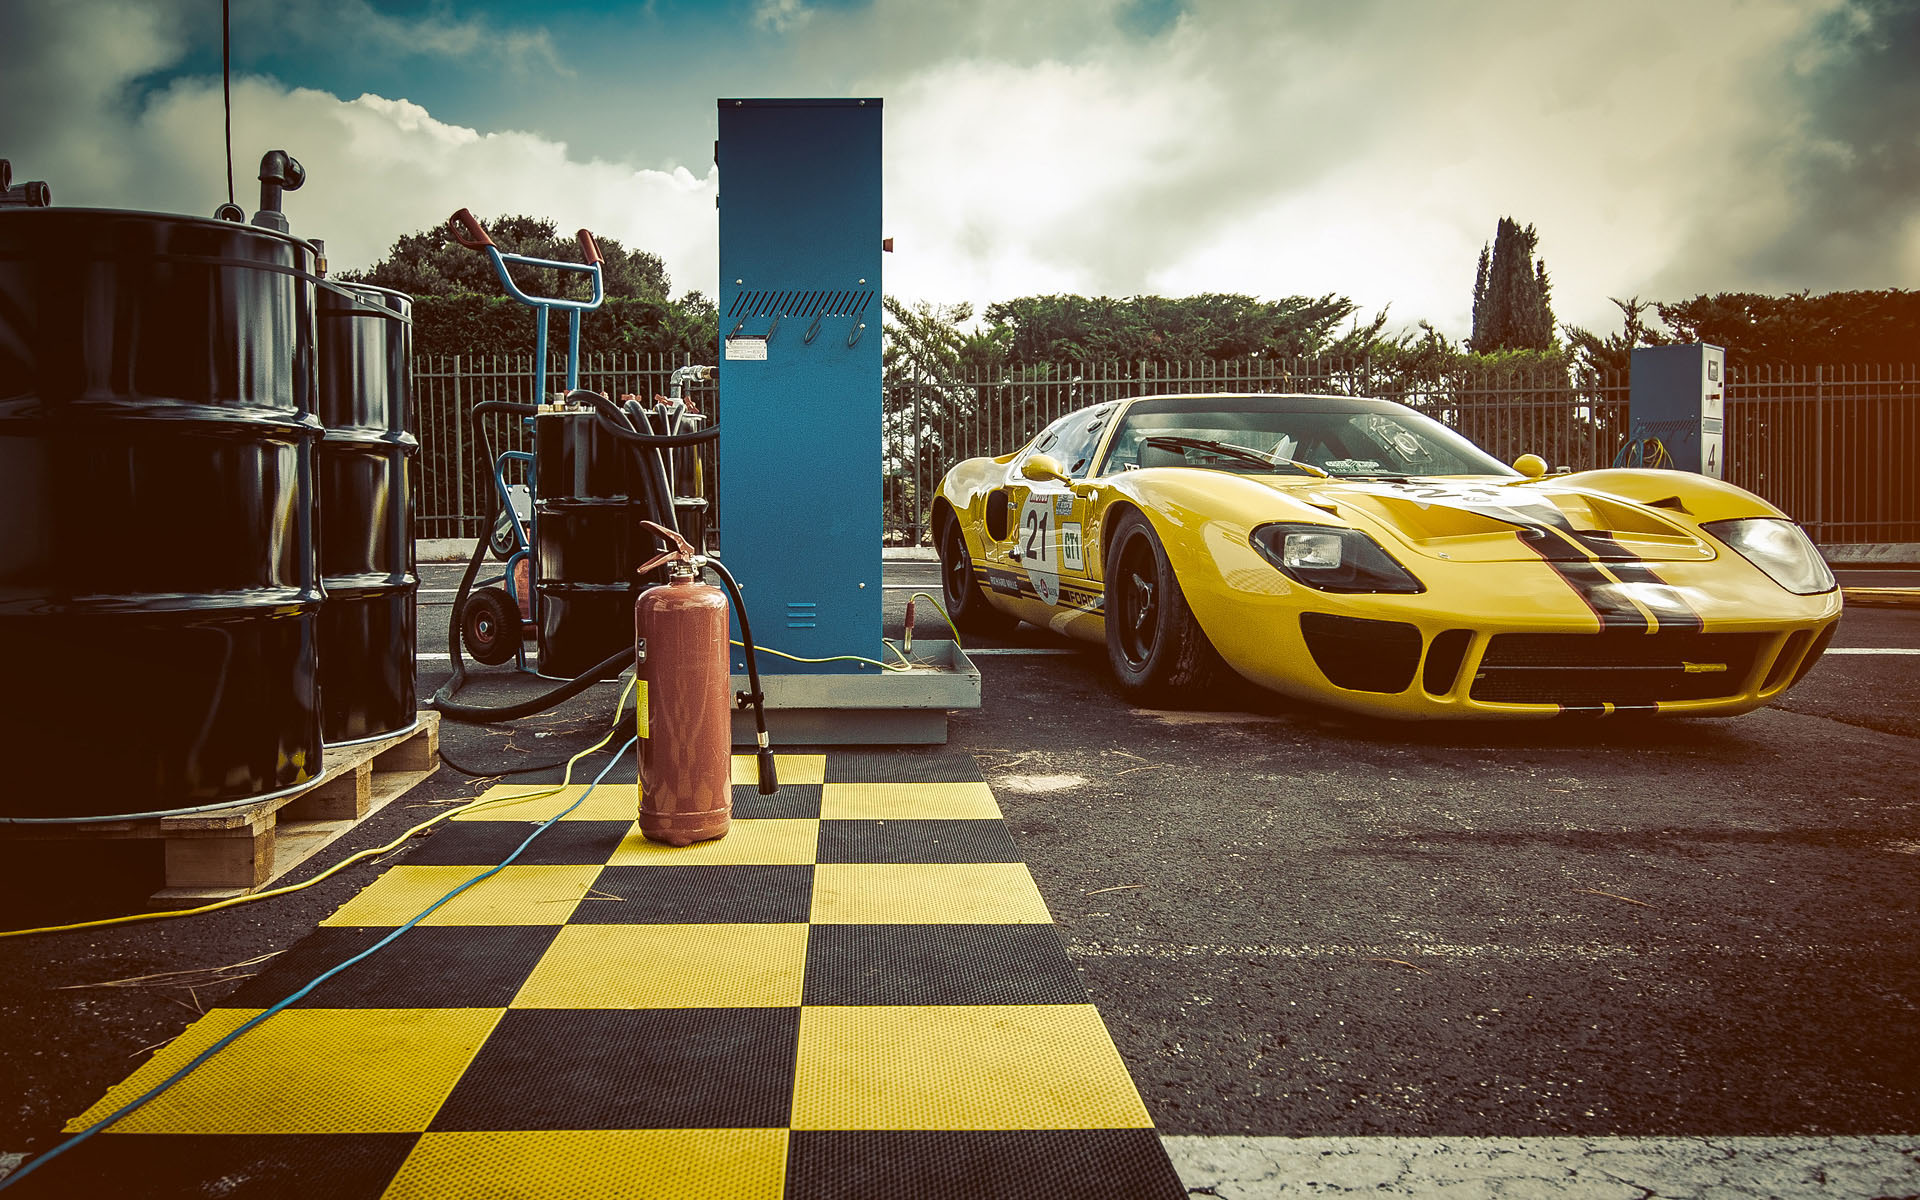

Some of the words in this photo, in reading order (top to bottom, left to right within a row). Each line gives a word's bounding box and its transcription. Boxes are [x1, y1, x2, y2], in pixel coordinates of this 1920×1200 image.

[1707, 443, 1715, 473] 4
[1026, 509, 1048, 562] 21
[1064, 532, 1080, 560] GT1
[1069, 591, 1096, 608] FORD
